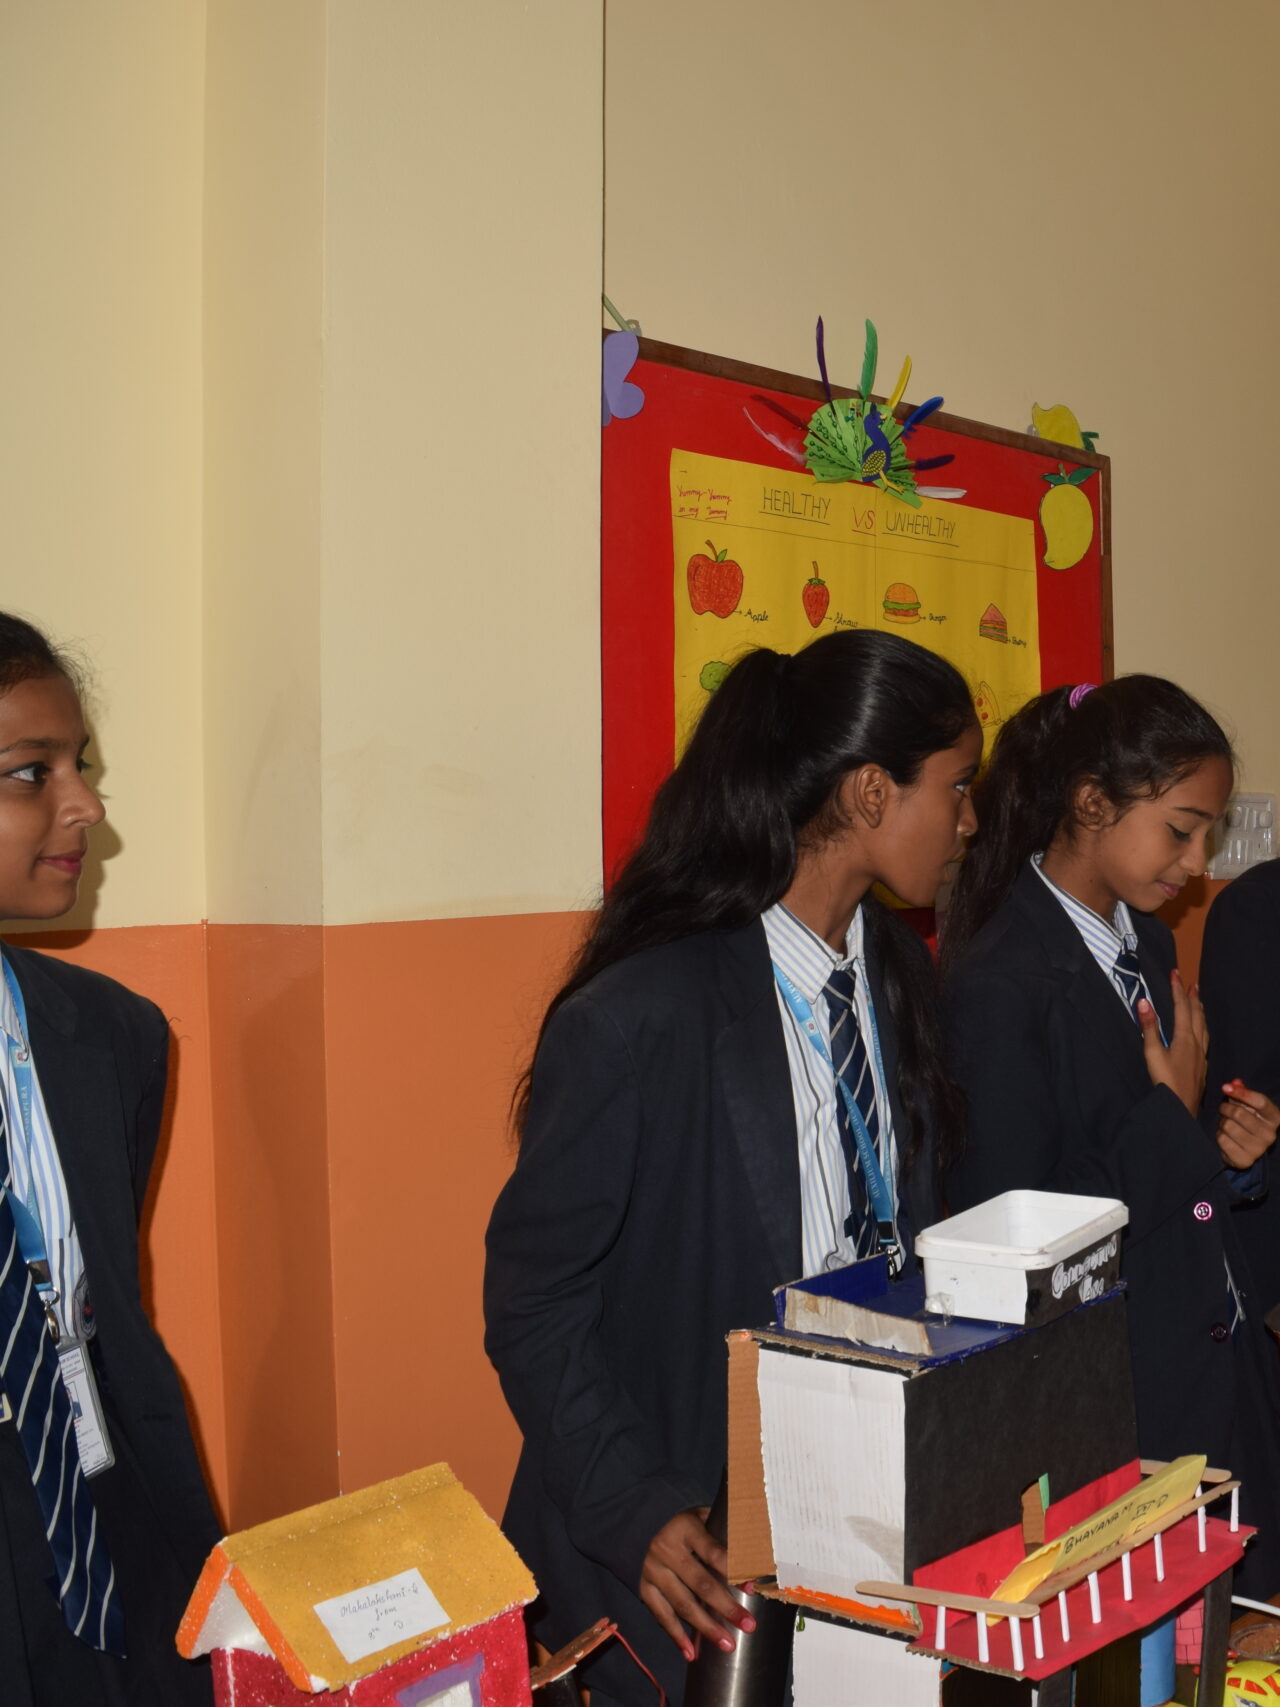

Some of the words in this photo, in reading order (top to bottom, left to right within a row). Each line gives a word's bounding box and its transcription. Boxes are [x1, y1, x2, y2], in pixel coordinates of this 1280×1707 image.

[763, 487, 831, 519] HEALTHY
[852, 508, 876, 530] VS
[885, 510, 956, 539] UNHEALTHY
[855, 1126, 870, 1161] SCHOOL
